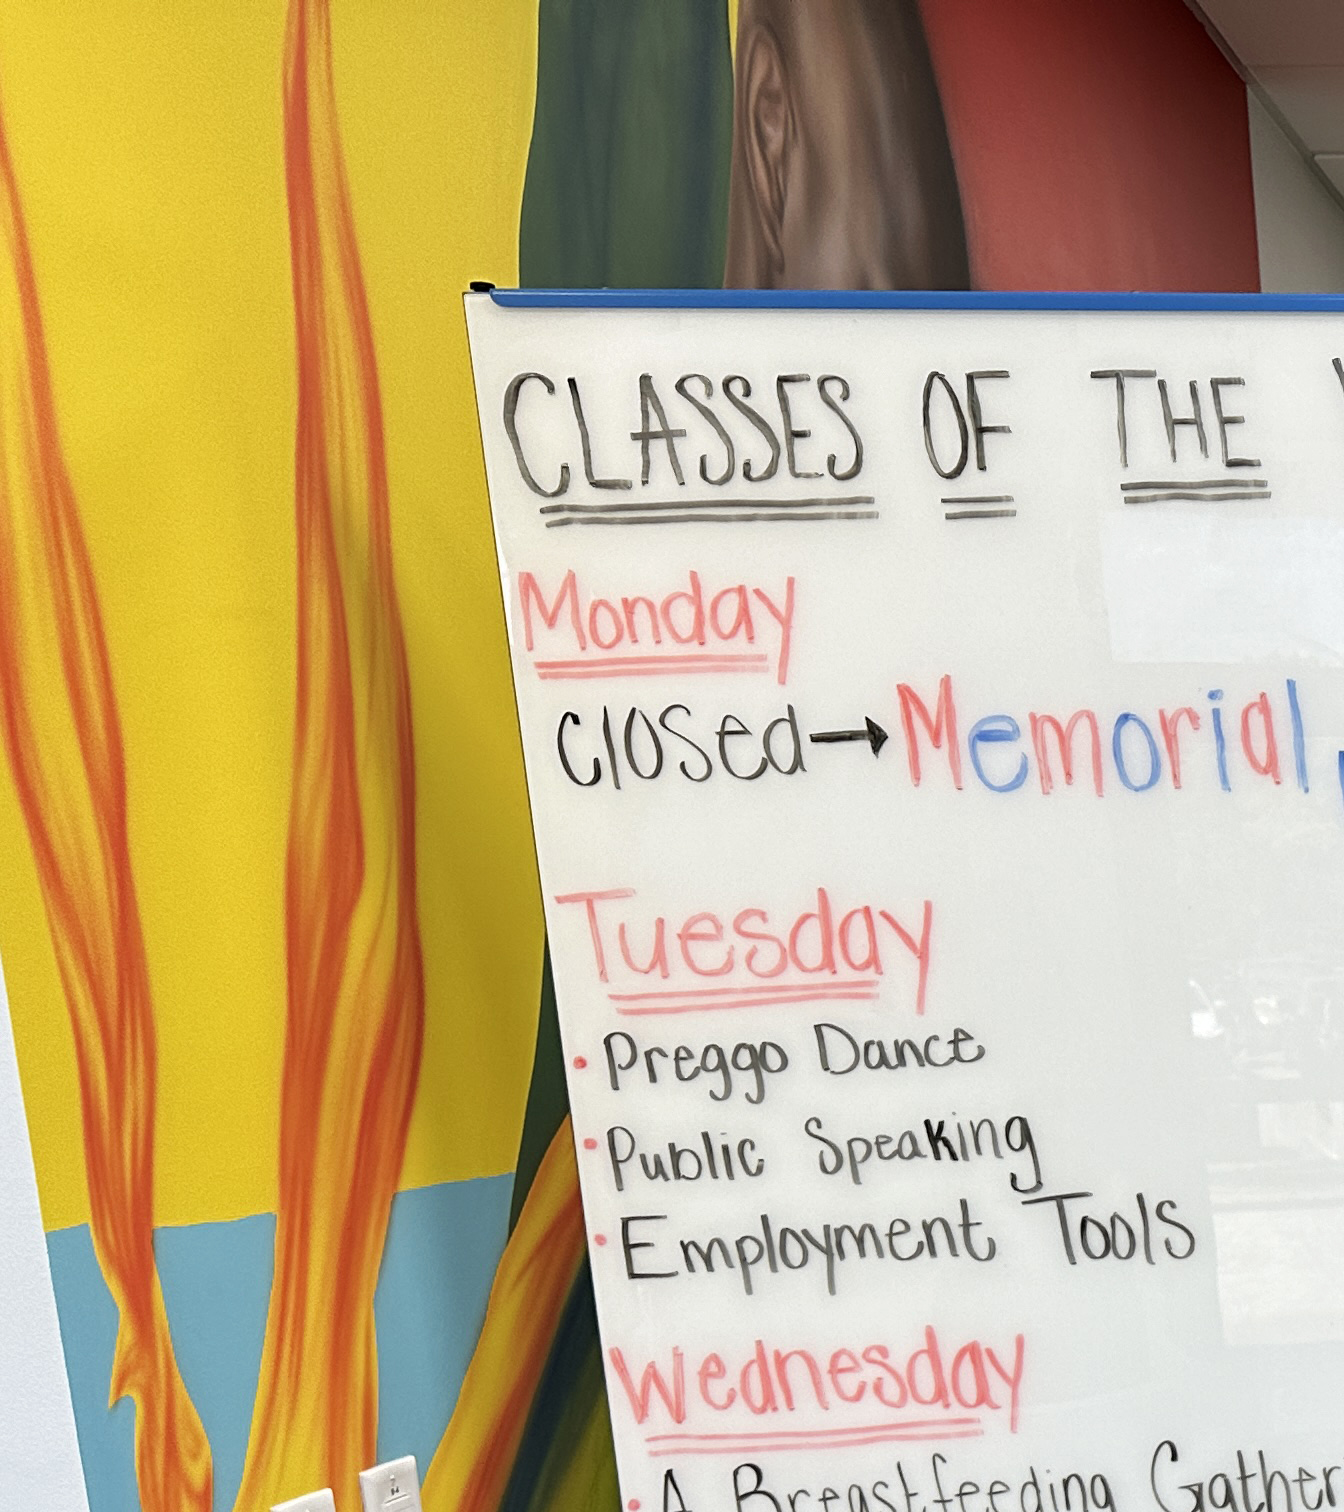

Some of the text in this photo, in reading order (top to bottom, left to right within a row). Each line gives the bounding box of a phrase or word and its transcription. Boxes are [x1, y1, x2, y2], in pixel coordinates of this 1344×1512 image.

[503, 371, 865, 497] CLASSES
[922, 370, 1012, 480] OF
[1090, 369, 1262, 468] THE
[518, 569, 795, 685] Monday
[896, 673, 1309, 798] Memorial
[555, 887, 933, 1016] Tuesday
[603, 1022, 986, 1105] Preggo Dance
[607, 1112, 1044, 1195] Public Speaking
[620, 1191, 1196, 1296] Employment Tools
[607, 1324, 1025, 1434] Wednesday
